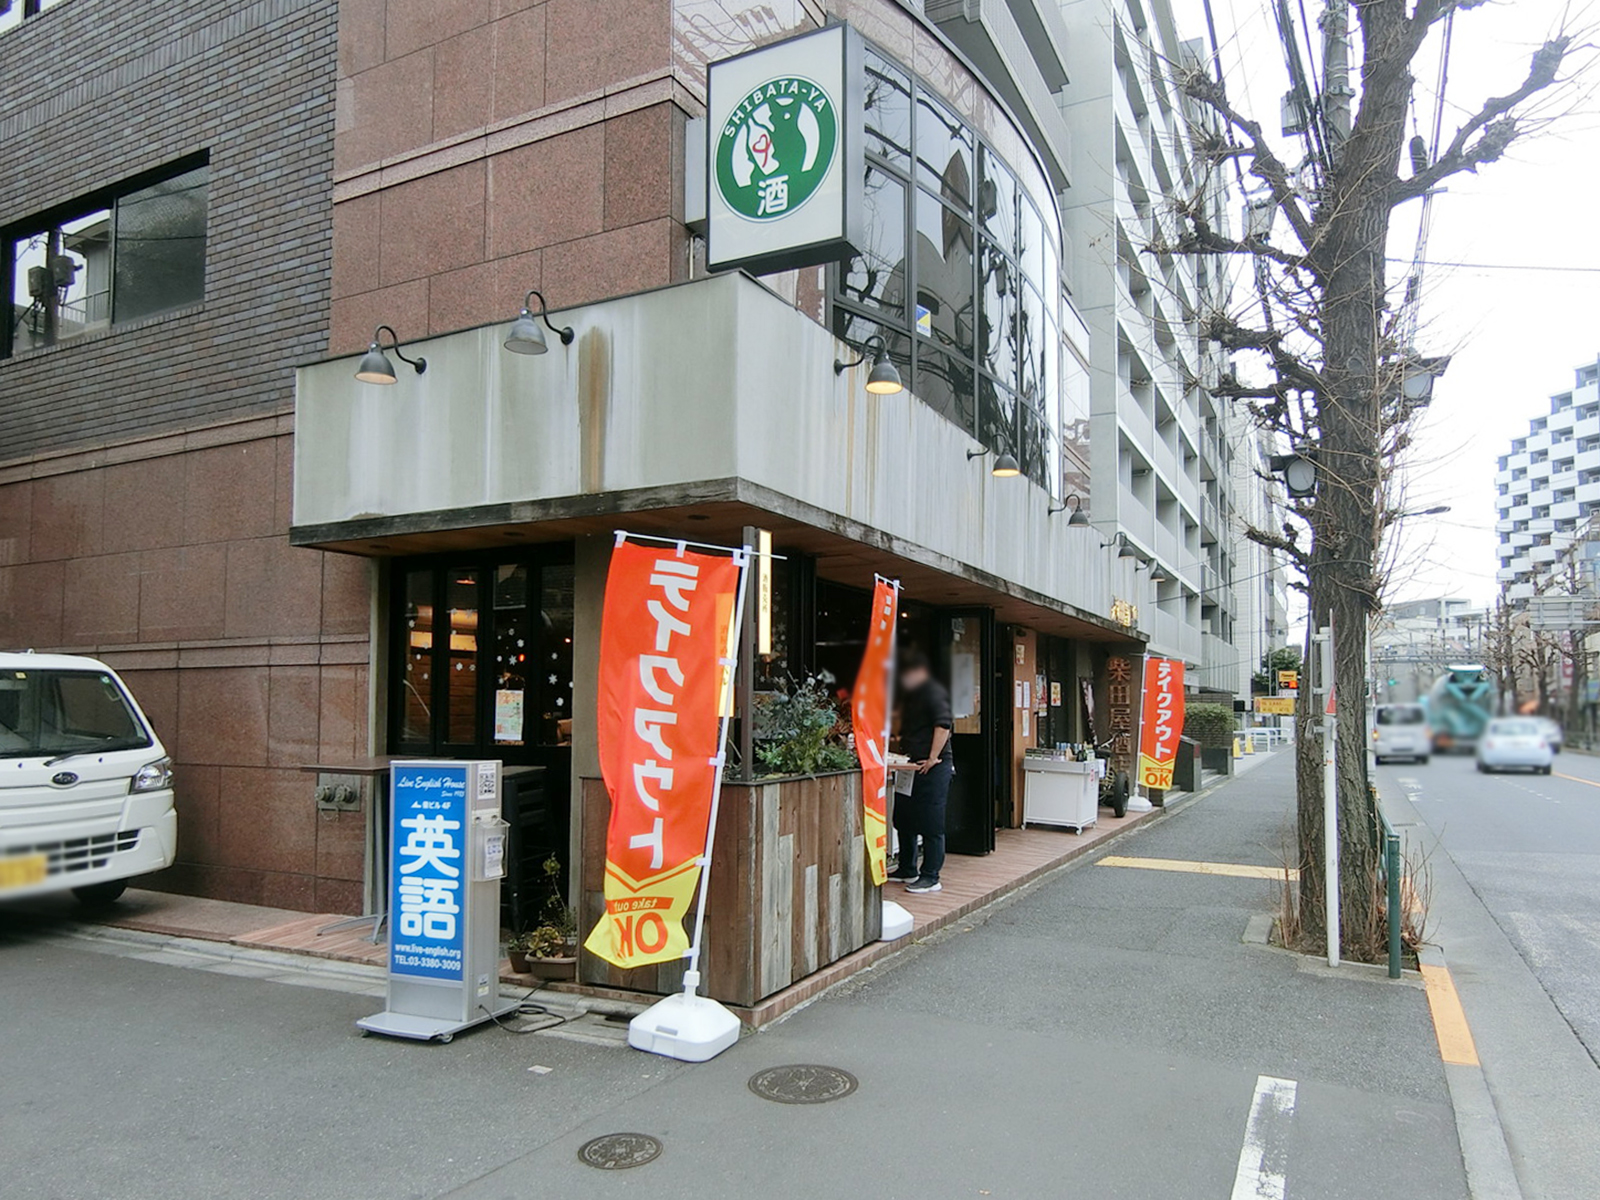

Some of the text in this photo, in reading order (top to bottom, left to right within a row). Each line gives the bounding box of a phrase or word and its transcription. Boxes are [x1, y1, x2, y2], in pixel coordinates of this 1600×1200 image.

[724, 80, 827, 138] SHIBATA-YA
[757, 175, 789, 216] 酒
[1155, 662, 1172, 759] テイクアウト
[397, 776, 465, 791] Live English House
[398, 813, 460, 940] 英語
[394, 954, 461, 971] TEL:03-3380-3009
[395, 944, 461, 960] www.live-english.org
